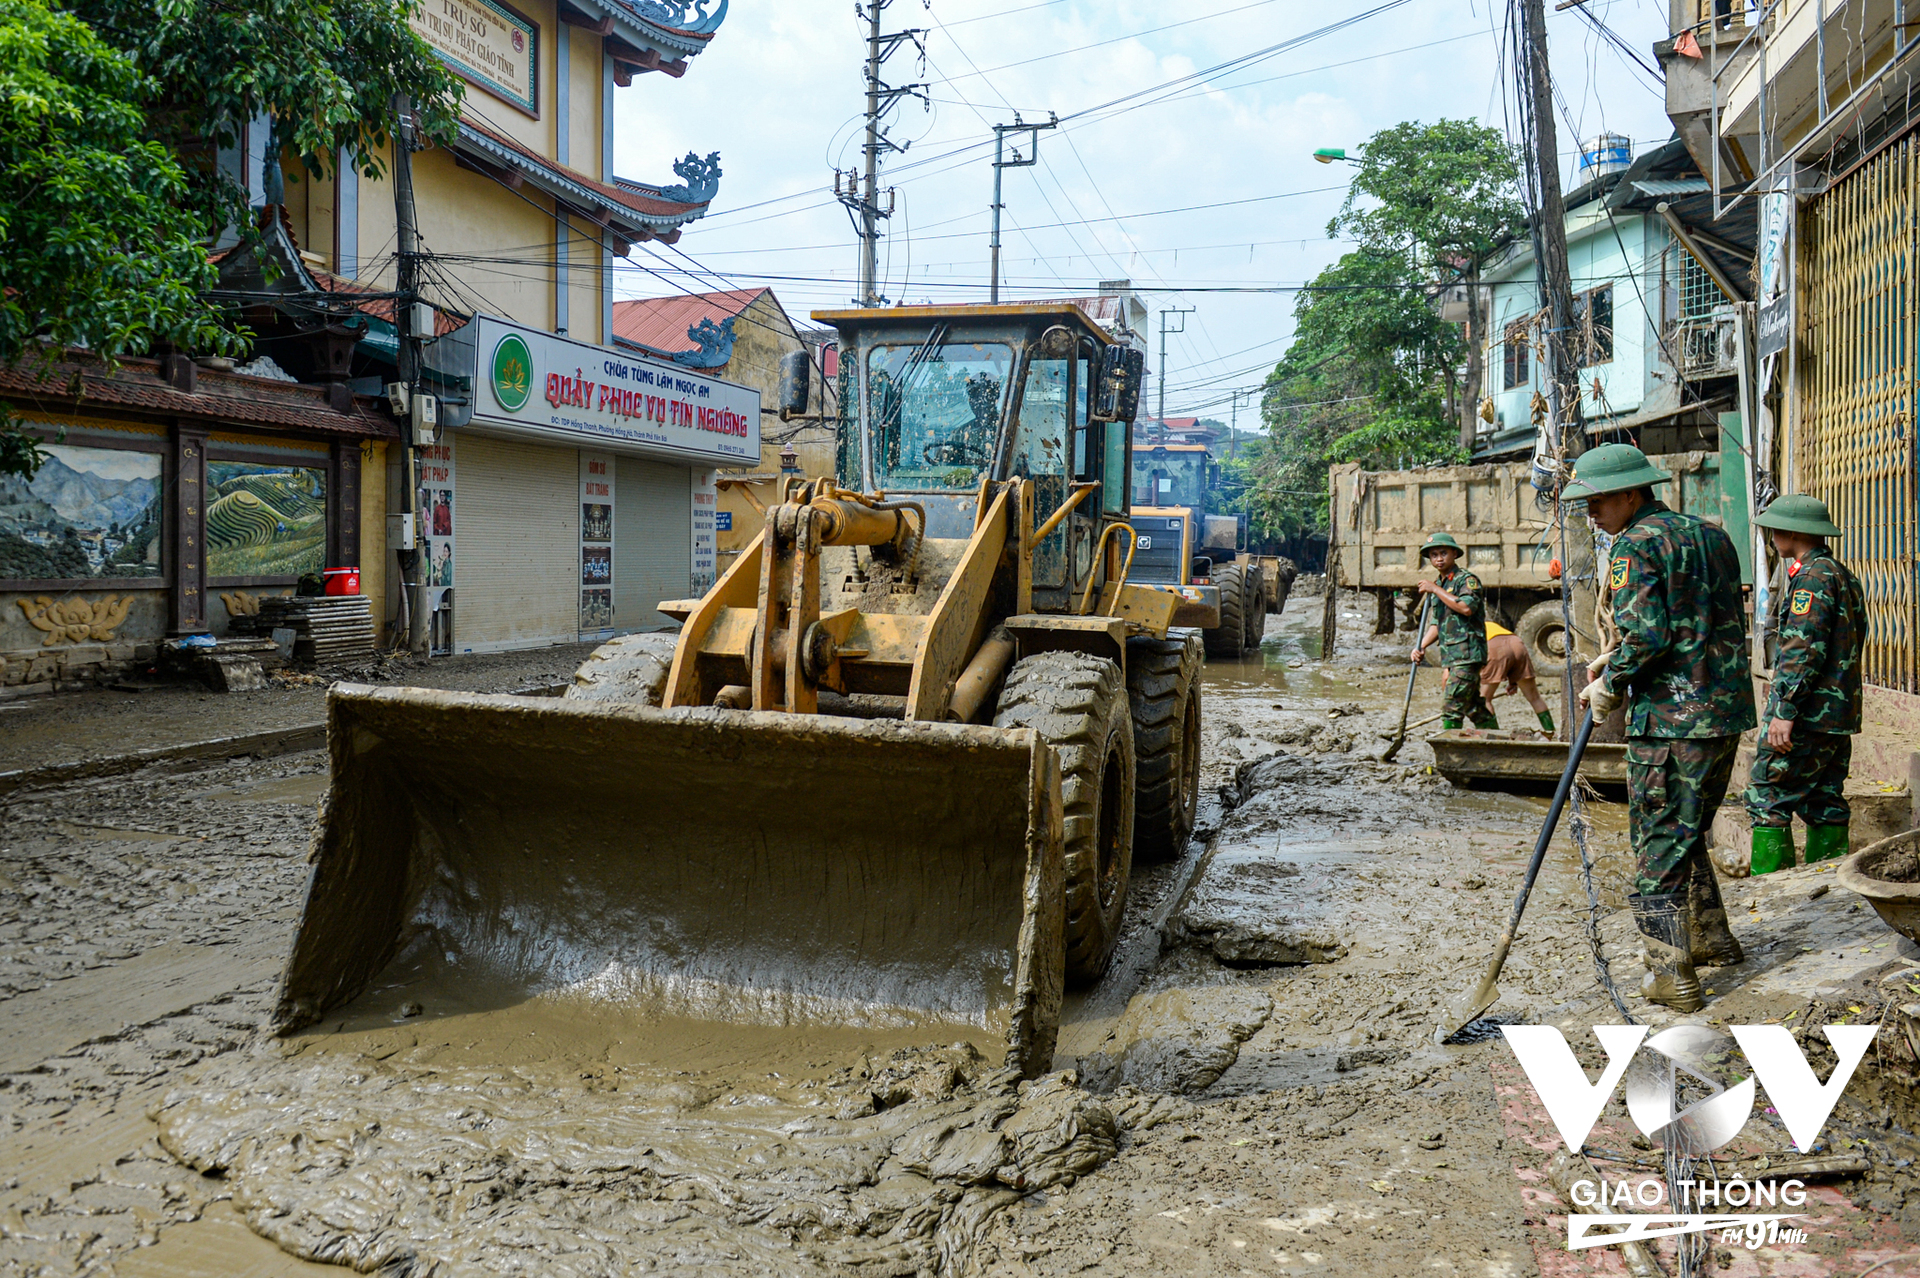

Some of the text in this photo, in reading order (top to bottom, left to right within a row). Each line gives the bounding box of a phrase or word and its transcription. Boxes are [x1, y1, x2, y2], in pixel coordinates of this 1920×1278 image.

[443, 0, 487, 38] TRỤ SỞ
[427, 12, 442, 37] TRỊ
[456, 28, 477, 54] PHẬT
[477, 44, 496, 66] GIÁO
[497, 53, 514, 78] TỈNH
[603, 360, 710, 398] CHÙA TÙNG LÂM NGỌC AM
[545, 367, 748, 438] QUẦY PHỤC VỤ TÍN NGƯỠNG
[434, 446, 451, 463] PHỤC
